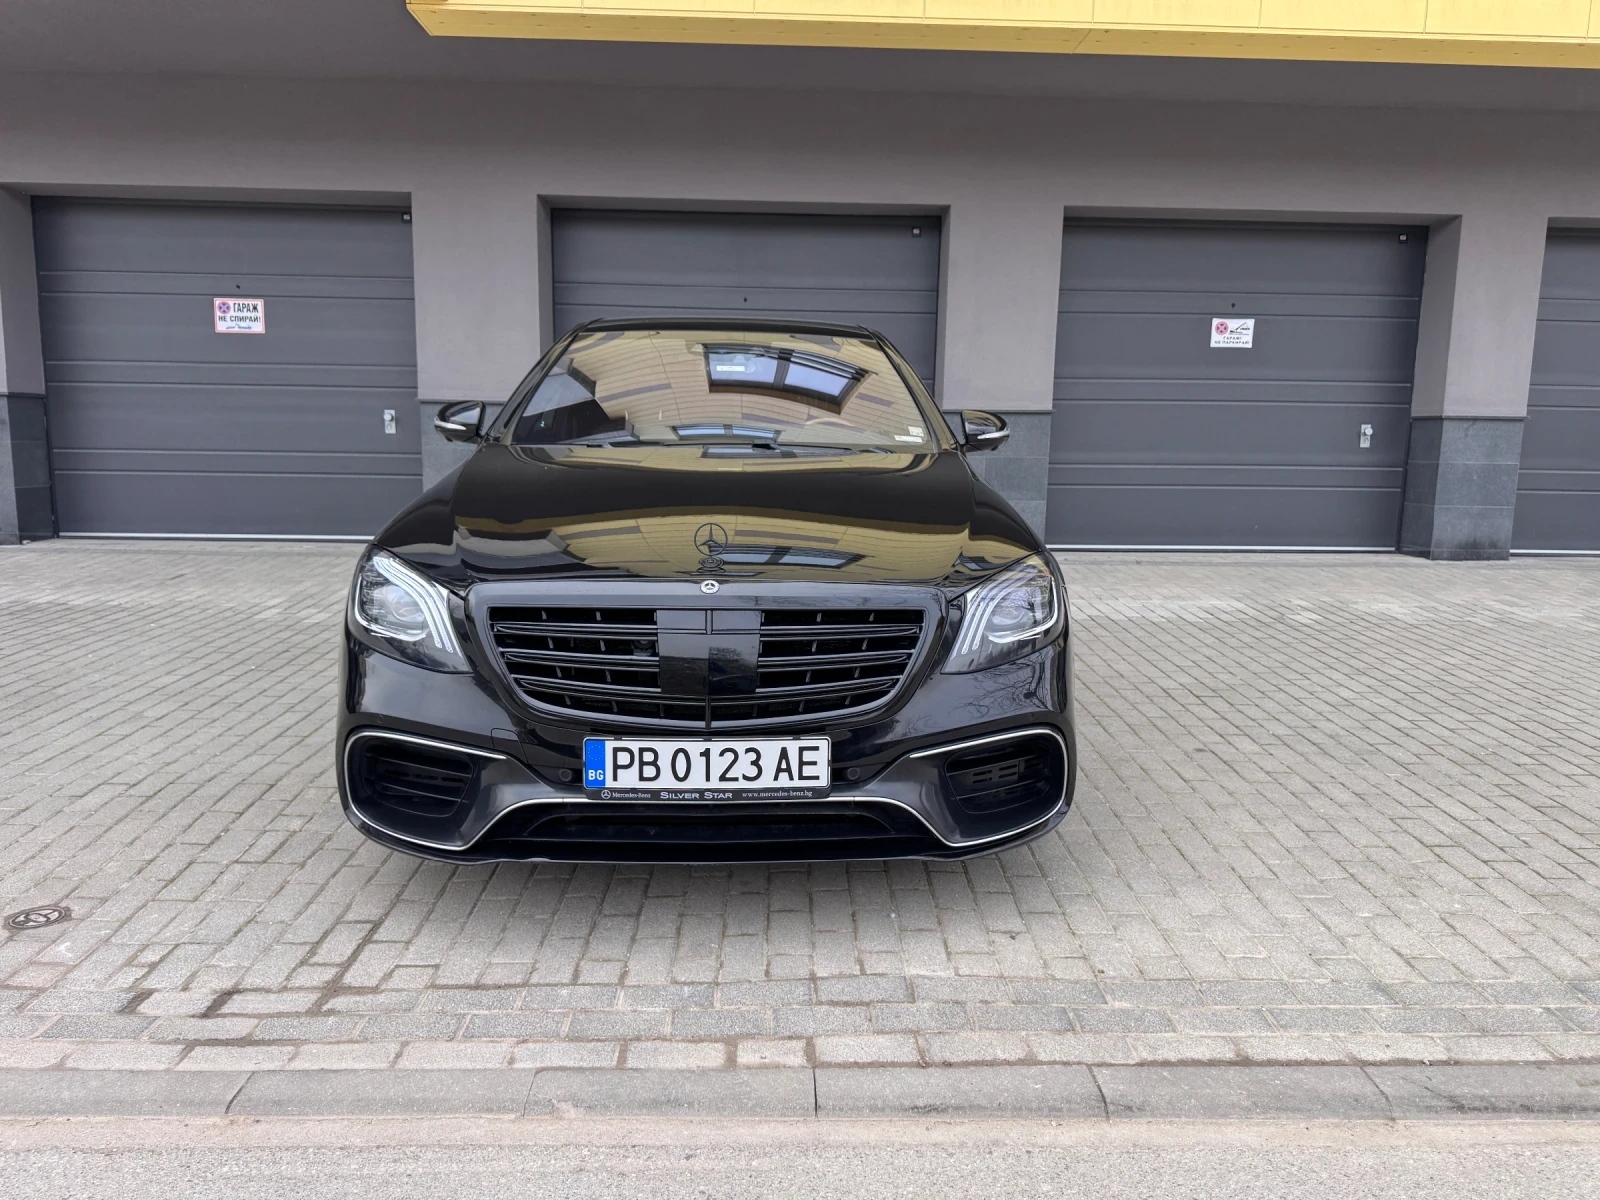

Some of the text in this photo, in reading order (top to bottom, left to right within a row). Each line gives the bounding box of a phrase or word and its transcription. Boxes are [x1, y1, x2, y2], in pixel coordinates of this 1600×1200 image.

[233, 302, 259, 313] ГАРАЖ
[230, 314, 261, 323] СПИРАЙ!
[612, 746, 820, 782] PB 0123 AE
[588, 770, 604, 780] BG
[704, 791, 733, 799] STAR
[742, 790, 812, 798] www.mercedes-benz.bg
